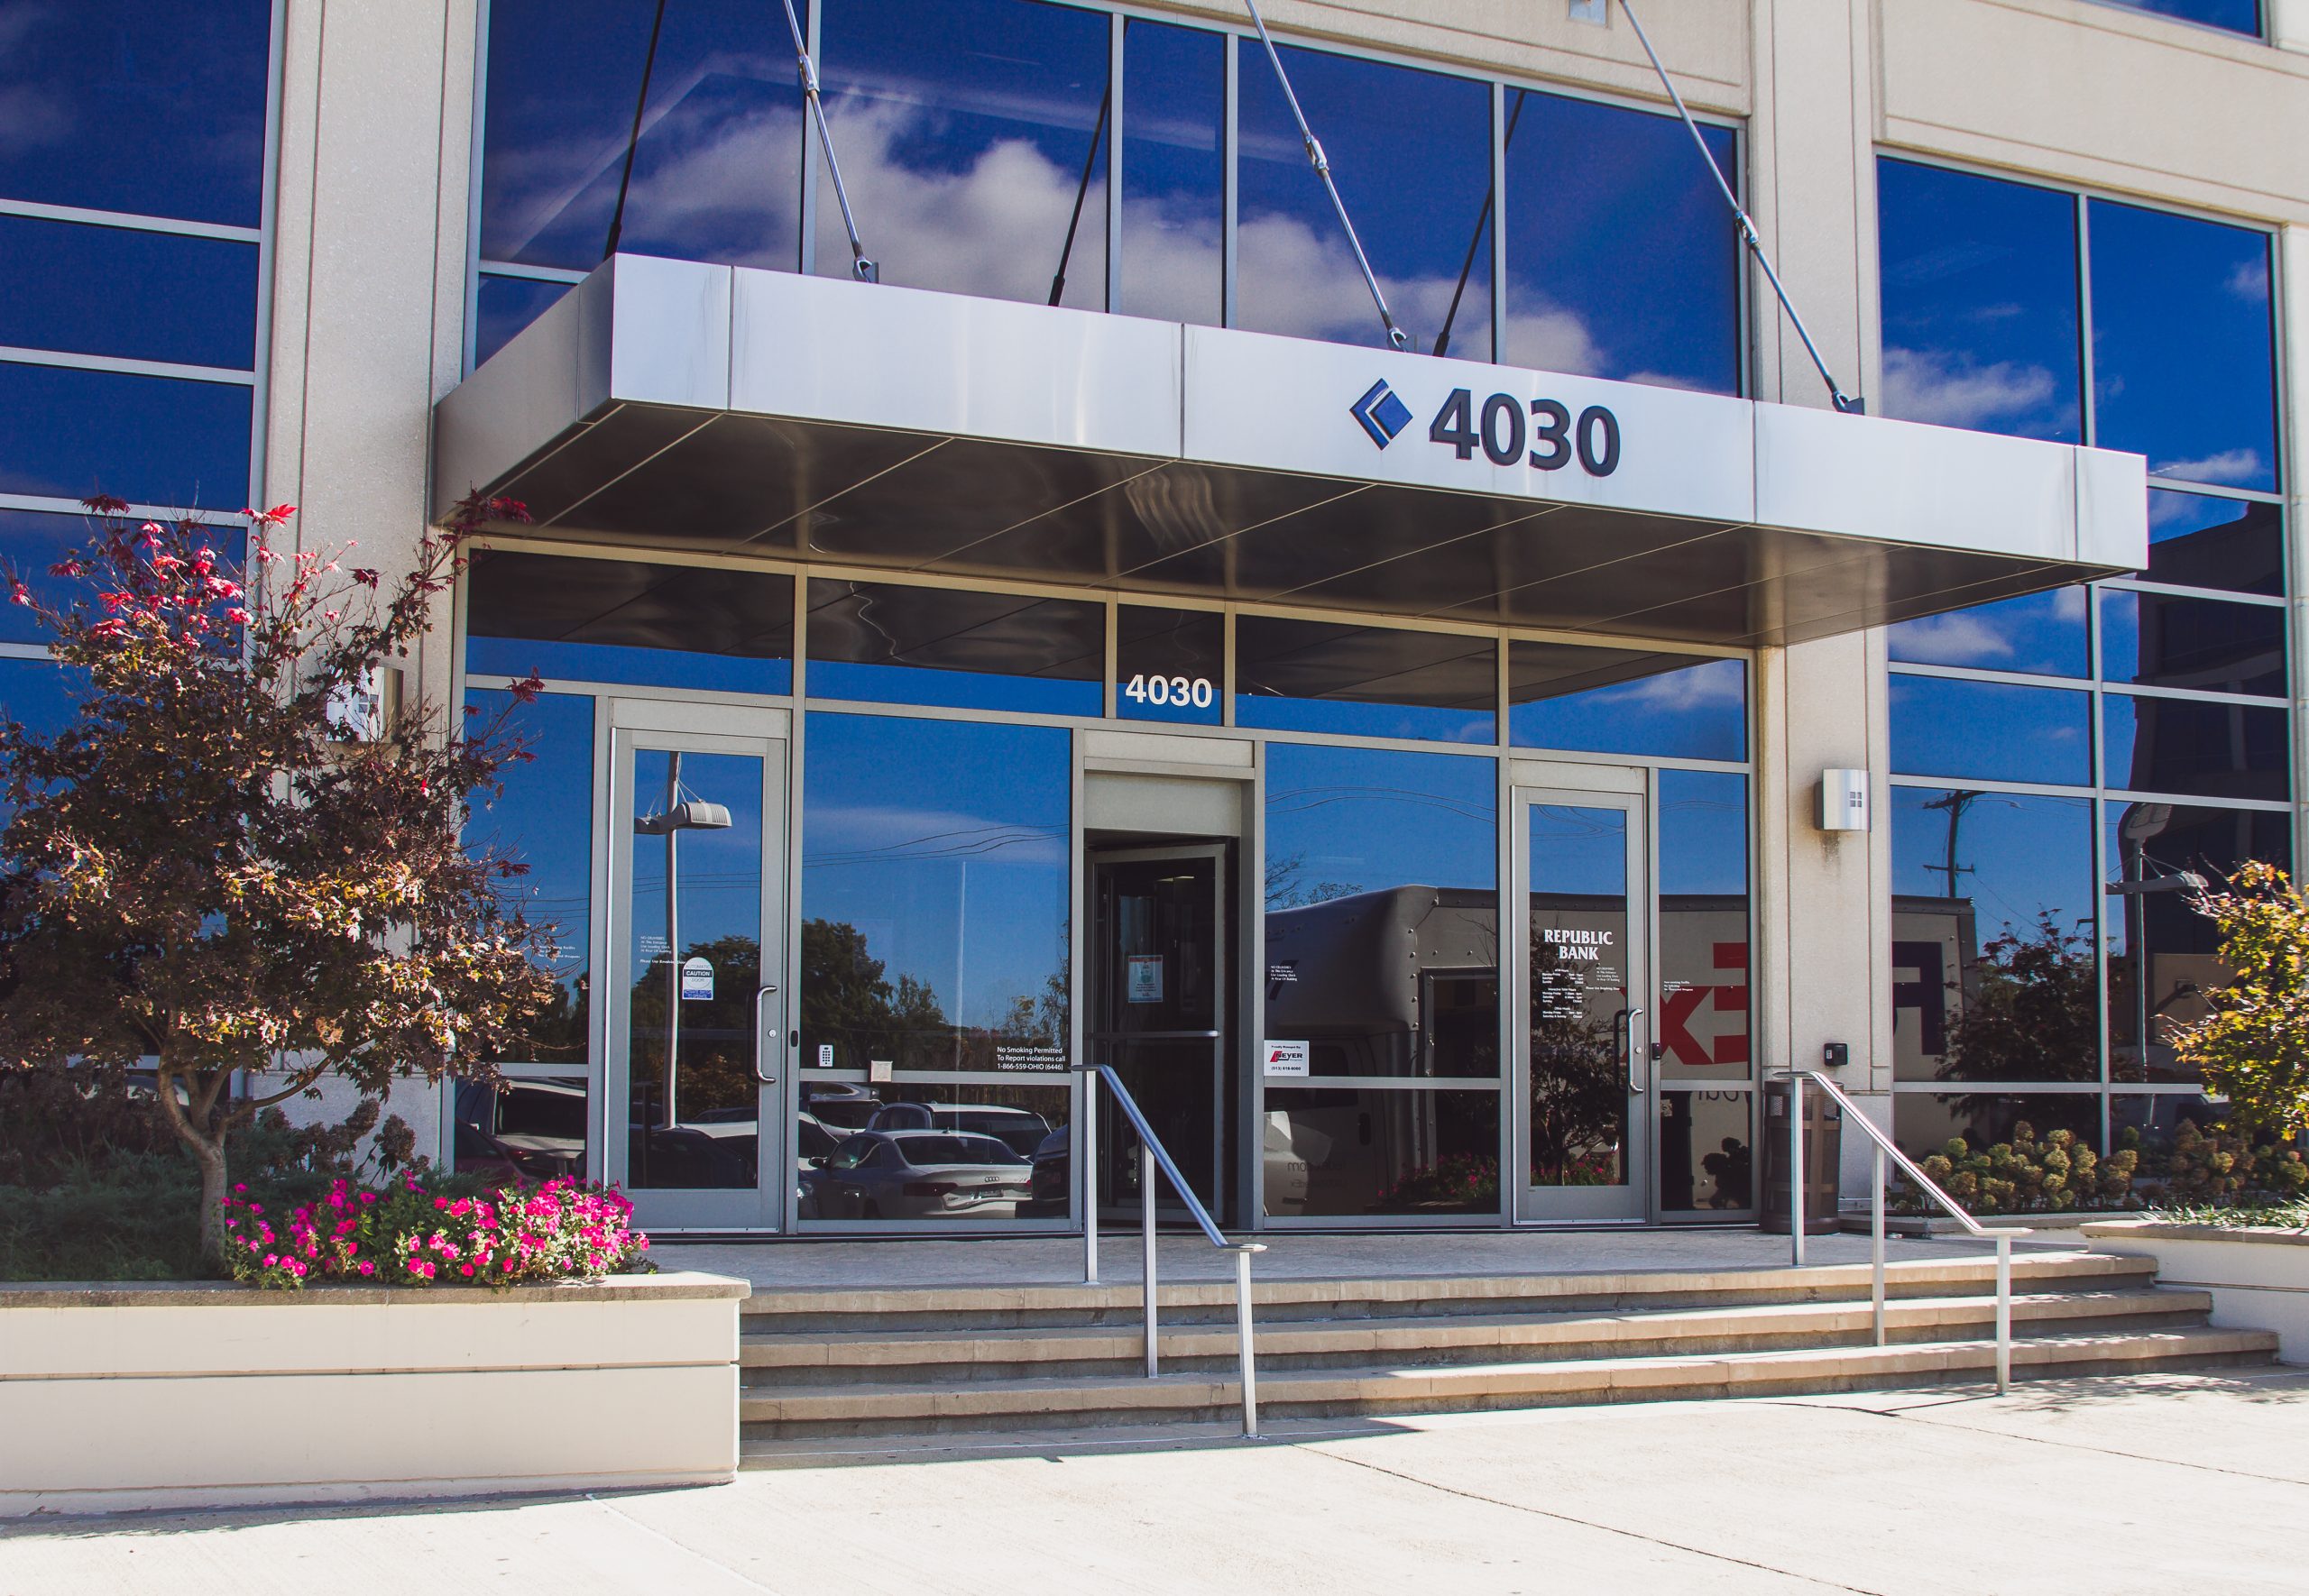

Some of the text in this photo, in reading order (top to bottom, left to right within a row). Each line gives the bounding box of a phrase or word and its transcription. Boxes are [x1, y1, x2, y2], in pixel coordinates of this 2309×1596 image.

[1429, 388, 1621, 478] 4030
[1125, 674, 1212, 708] 4030
[1544, 929, 1614, 945] REPUBLIC
[1559, 945, 1599, 960] BANK
[1007, 1046, 1033, 1054] Smoking
[1005, 1054, 1026, 1062] Report
[1045, 1063, 1063, 1071] (6446)
